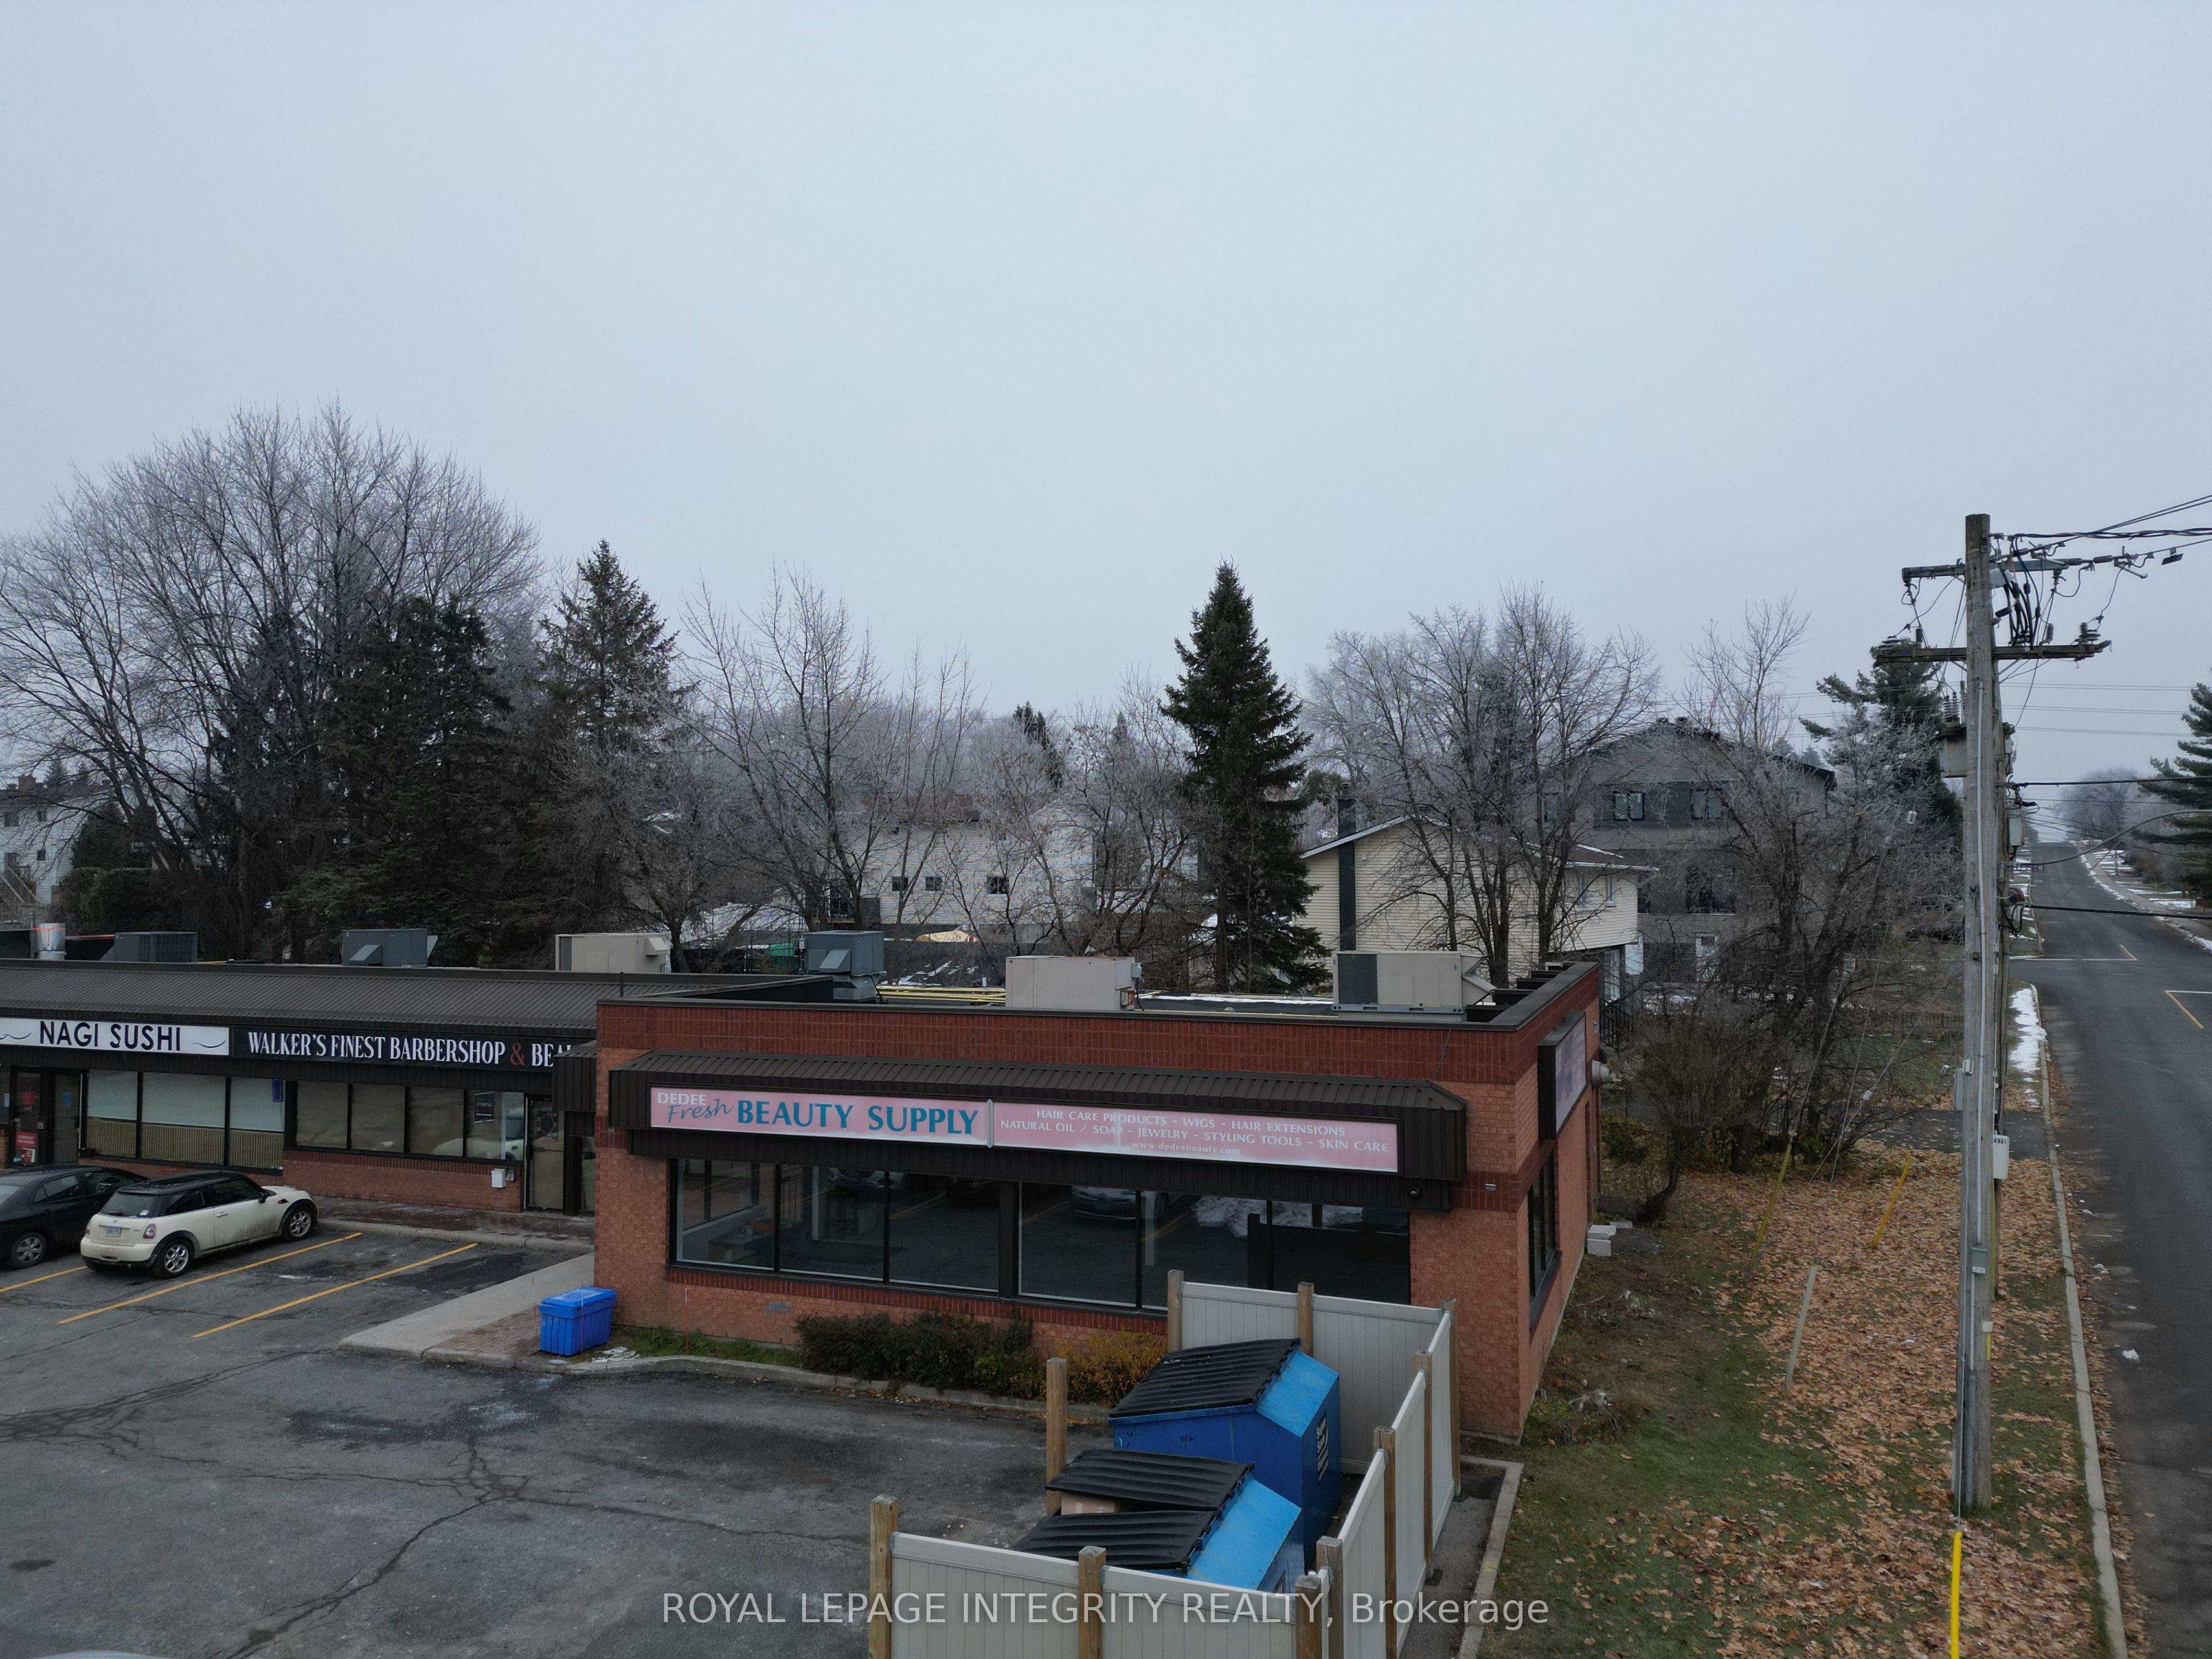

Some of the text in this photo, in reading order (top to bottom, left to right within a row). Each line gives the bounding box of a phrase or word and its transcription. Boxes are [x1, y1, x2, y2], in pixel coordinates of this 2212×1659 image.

[40, 1020, 181, 1051] NAGI SUSHI
[248, 1032, 572, 1067] WALKER'S FINEST BARBERSHOP & BE
[658, 1092, 707, 1105] DEDEE
[668, 1099, 978, 1135] Fresh BEAUTY SUPPLY
[1036, 1109, 1063, 1119] HAIR
[1069, 1111, 1098, 1121] CARE
[1103, 1113, 1168, 1125] PRODUCTS
[1183, 1118, 1215, 1128] WIGS
[1232, 1120, 1261, 1131] HAIR
[1267, 1123, 1346, 1135] EXTENSIONS
[1001, 1120, 1051, 1131] NATURAL
[1055, 1123, 1075, 1132] OIL
[1093, 1125, 1123, 1135] SOAP
[1138, 1128, 1188, 1139] JEWELRY
[1205, 1132, 1255, 1143] STYLING
[1260, 1135, 1302, 1146] TOOLS
[1319, 1139, 1348, 1149] SKIN
[1354, 1141, 1389, 1152] CARE
[1132, 1142, 1240, 1155] www.dedeebeauty.com
